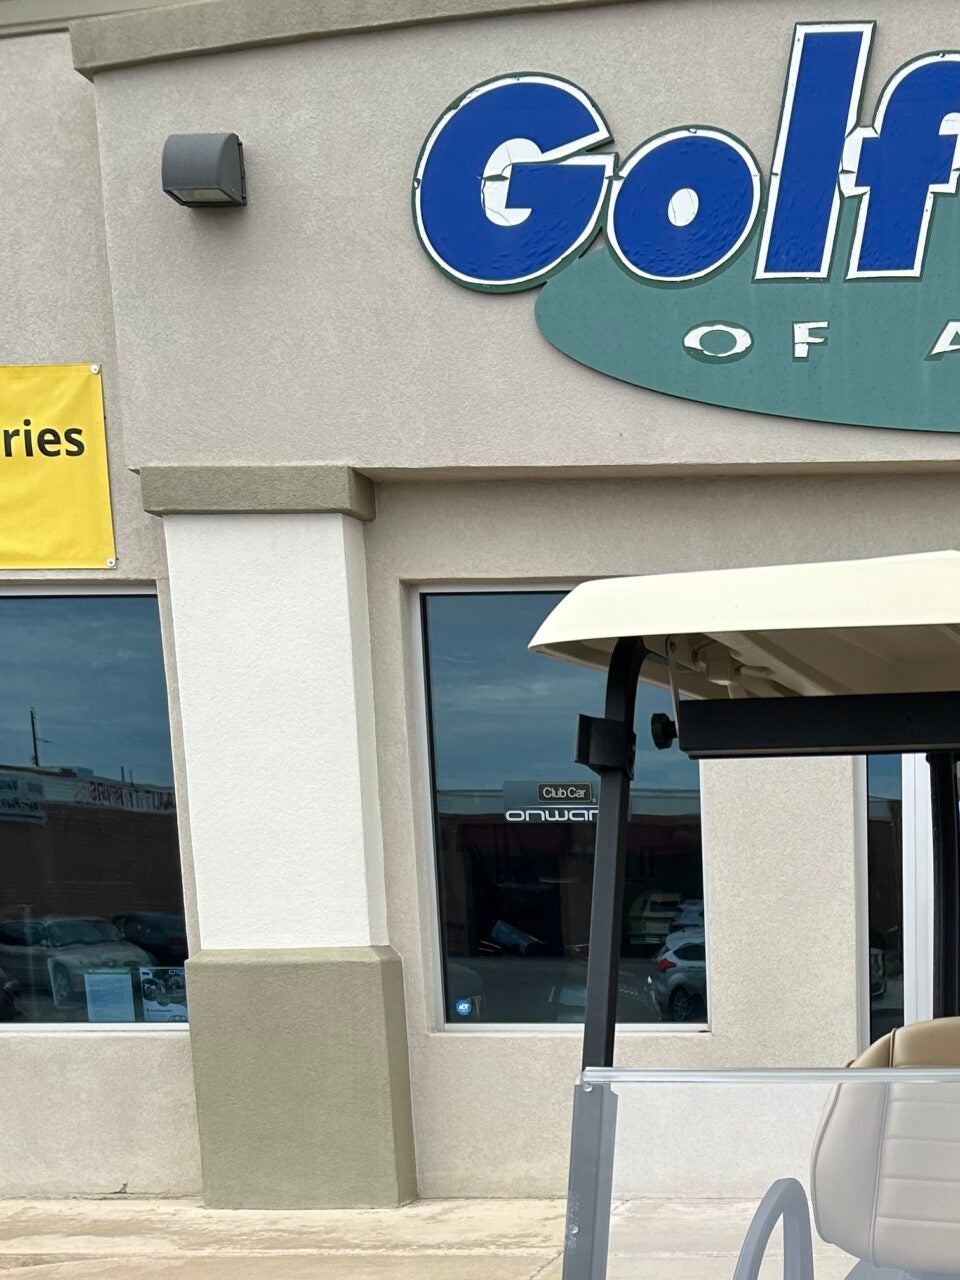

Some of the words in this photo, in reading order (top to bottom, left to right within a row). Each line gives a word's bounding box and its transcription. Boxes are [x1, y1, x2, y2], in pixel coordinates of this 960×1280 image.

[683, 320, 829, 358] OF
[3, 418, 85, 458] ries
[542, 786, 567, 798] Club
[567, 786, 586, 798] Car
